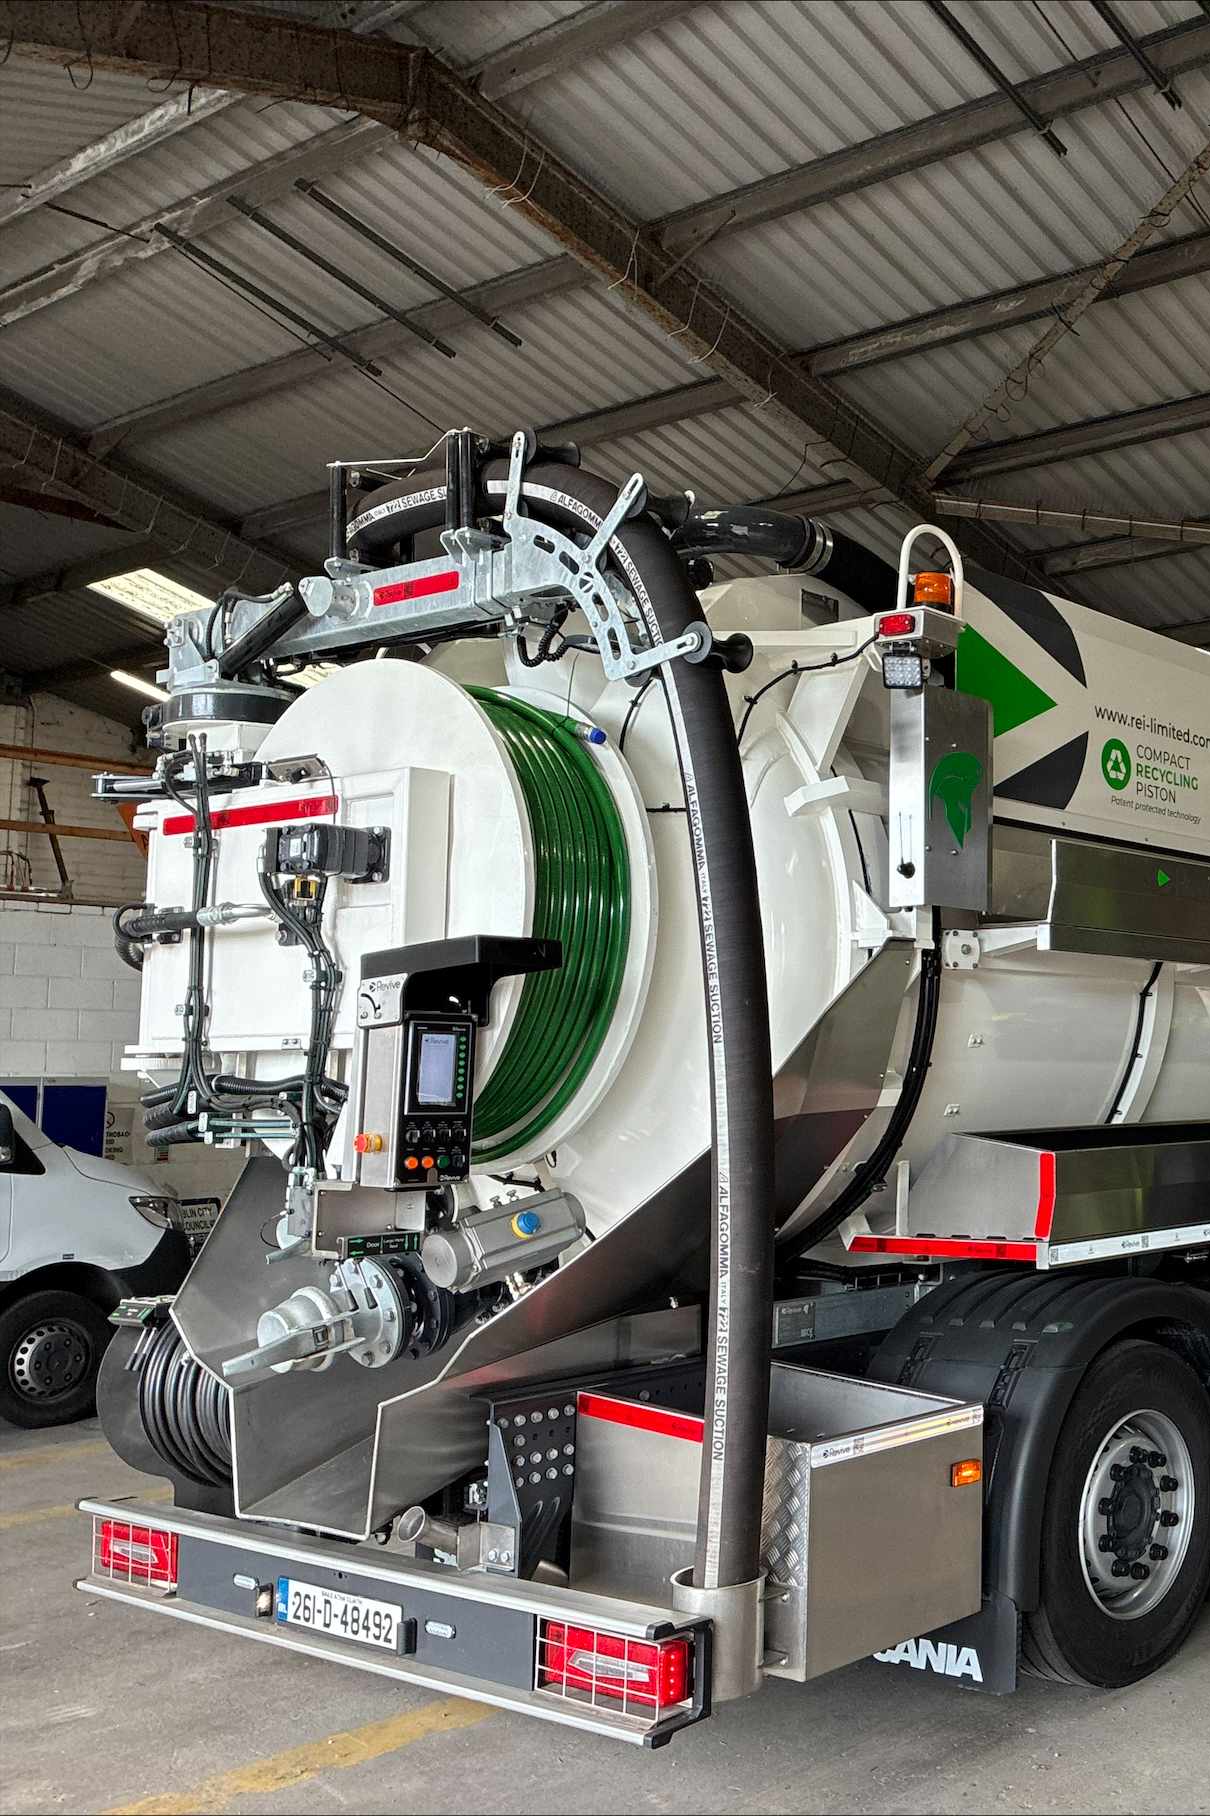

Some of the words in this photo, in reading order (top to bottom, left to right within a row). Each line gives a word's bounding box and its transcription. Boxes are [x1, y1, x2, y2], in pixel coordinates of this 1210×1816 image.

[402, 490, 437, 509] SEWAGE
[557, 493, 603, 531] ALFAGOMM
[625, 561, 648, 609] SEWAGE
[645, 608, 664, 647] SUCTIO
[1136, 744, 1191, 771] COMPACT
[1136, 763, 1199, 790] RECYCLING
[1111, 795, 1134, 809] Patent
[1134, 801, 1166, 817] protected
[1167, 807, 1202, 825] technology
[1136, 781, 1177, 804] PISTON
[686, 785, 706, 870] ALFAGOMMA
[704, 923, 717, 980] SEWAGE
[376, 980, 401, 992] Revive
[709, 984, 723, 1044] SUCTION
[183, 1208, 196, 1218] BLIN
[197, 1207, 212, 1218] CITY
[366, 1241, 380, 1249] Door
[719, 1185, 729, 1279] ALFAGOMMA
[715, 1336, 728, 1395] SEWAGE
[713, 1399, 726, 1461] SUCTION
[829, 1445, 851, 1457] Revive
[293, 1591, 393, 1644] 261-D-48492
[873, 1638, 984, 1683] ANIA
